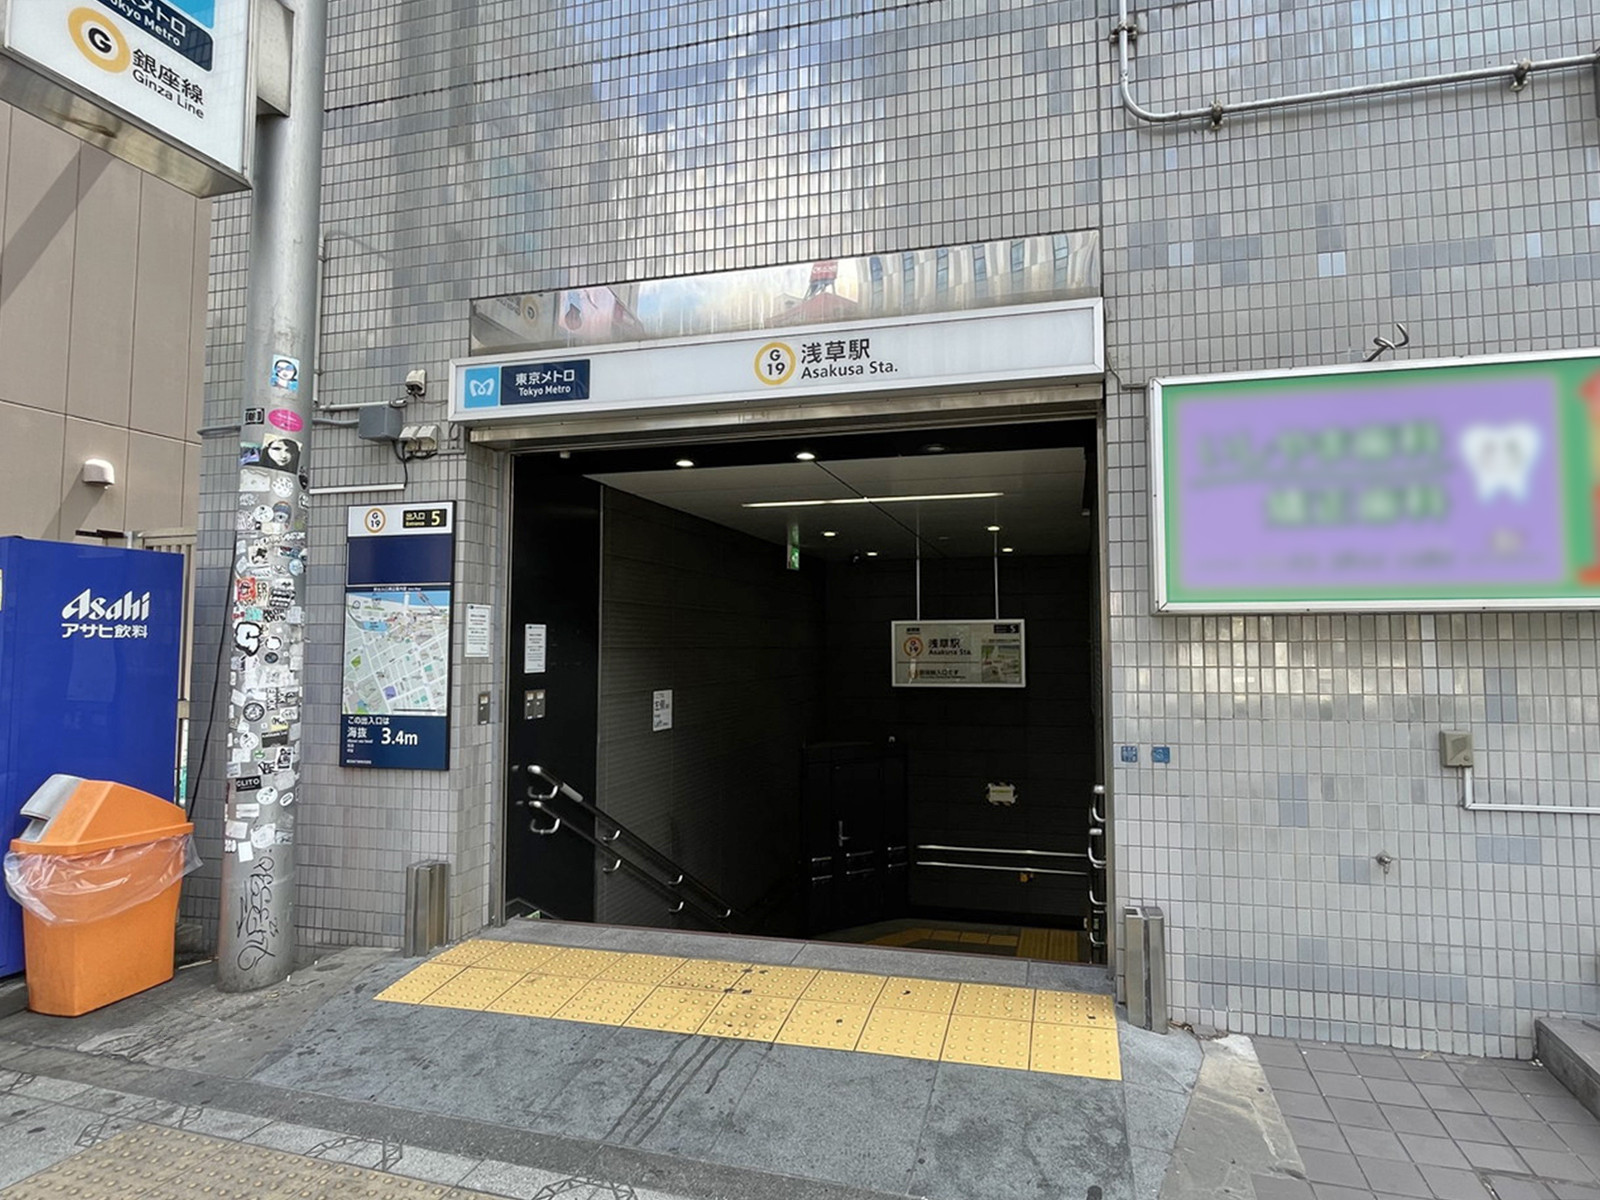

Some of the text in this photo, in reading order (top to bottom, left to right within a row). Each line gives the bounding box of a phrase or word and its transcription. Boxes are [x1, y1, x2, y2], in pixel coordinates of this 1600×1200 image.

[144, 15, 180, 46] Metro
[88, 27, 112, 53] G
[133, 49, 203, 105] 銀座線
[133, 69, 204, 119] Ginza Line
[769, 349, 781, 361] G
[801, 338, 870, 364] 浅草駅
[767, 362, 785, 375] 19
[801, 360, 898, 379] Asakusa Sta.
[515, 369, 575, 386] 東京メトロ
[519, 385, 571, 398] Tokyo Metro
[371, 520, 381, 528] 19
[431, 511, 440, 526] 5
[62, 588, 150, 620] Asahi
[61, 623, 148, 638] アサヒ飲料
[348, 716, 390, 725] この出入口は
[381, 727, 418, 745] 3.4m
